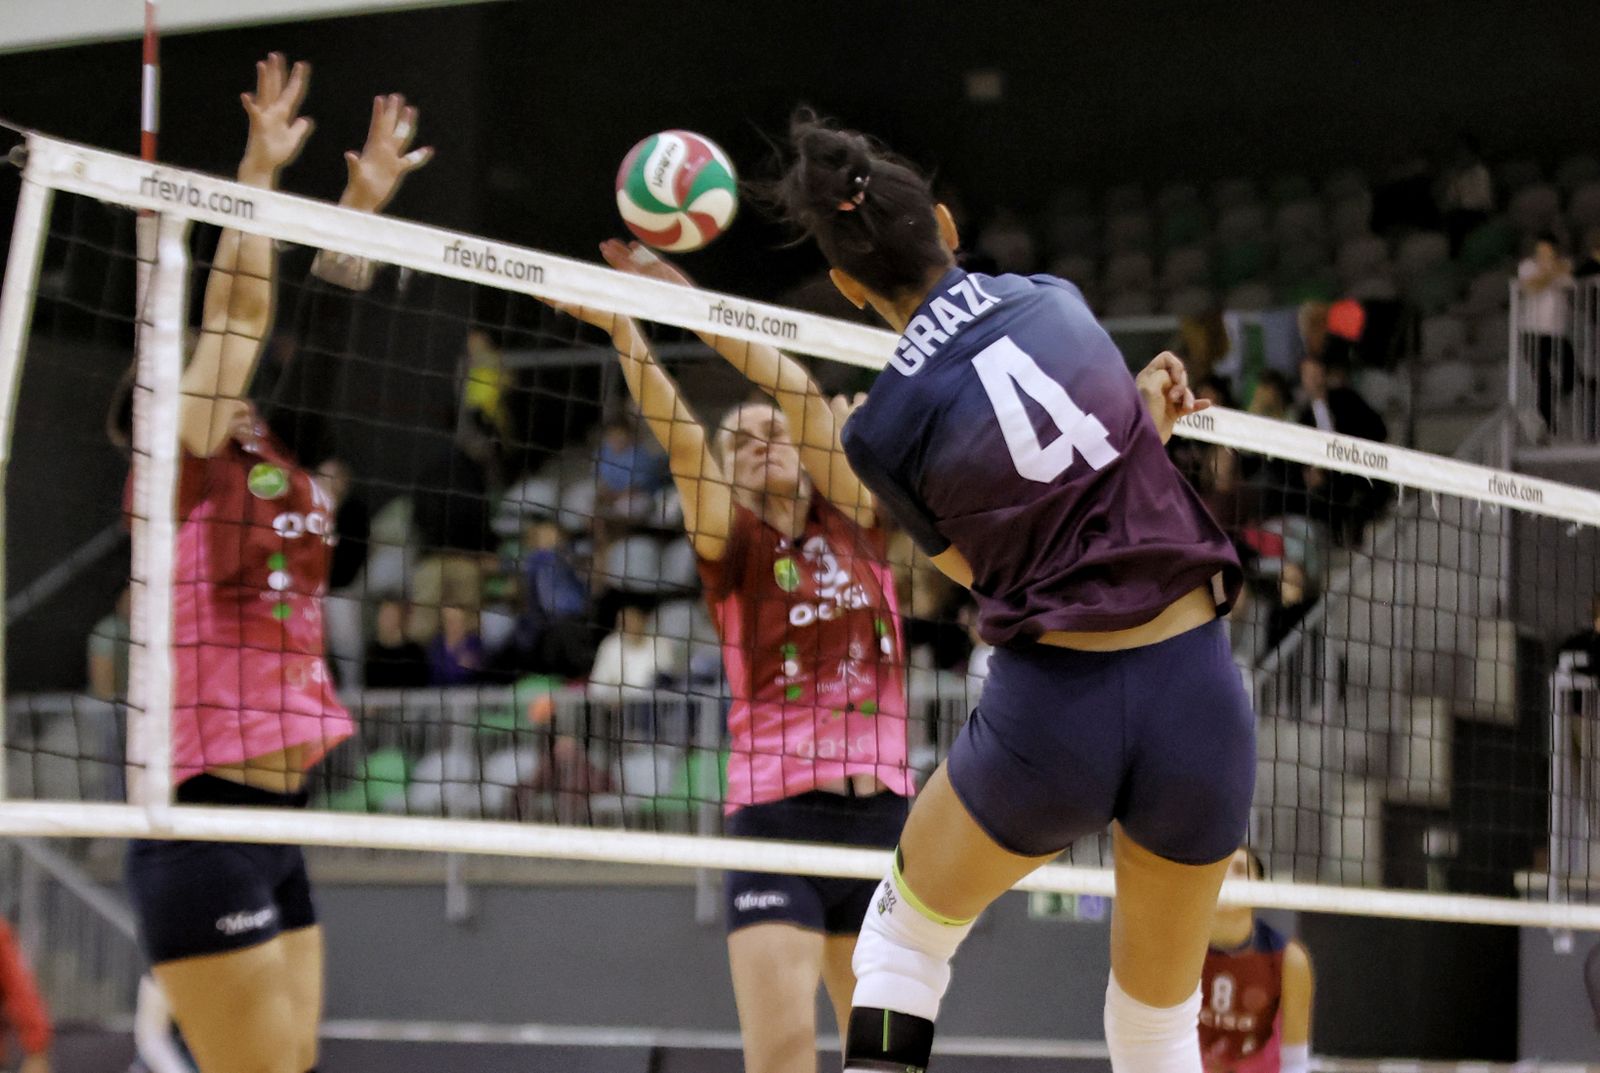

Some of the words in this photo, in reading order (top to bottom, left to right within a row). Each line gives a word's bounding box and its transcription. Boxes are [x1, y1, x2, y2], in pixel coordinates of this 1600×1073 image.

[140, 169, 254, 219] rfevb.com
[442, 239, 545, 284] rfevb.com
[708, 299, 797, 339] rfevb.com
[971, 335, 1120, 483] 4
[1326, 439, 1388, 470] rfevb.com
[1488, 473, 1543, 504] rfevb.com
[1211, 975, 1232, 1013] 8
